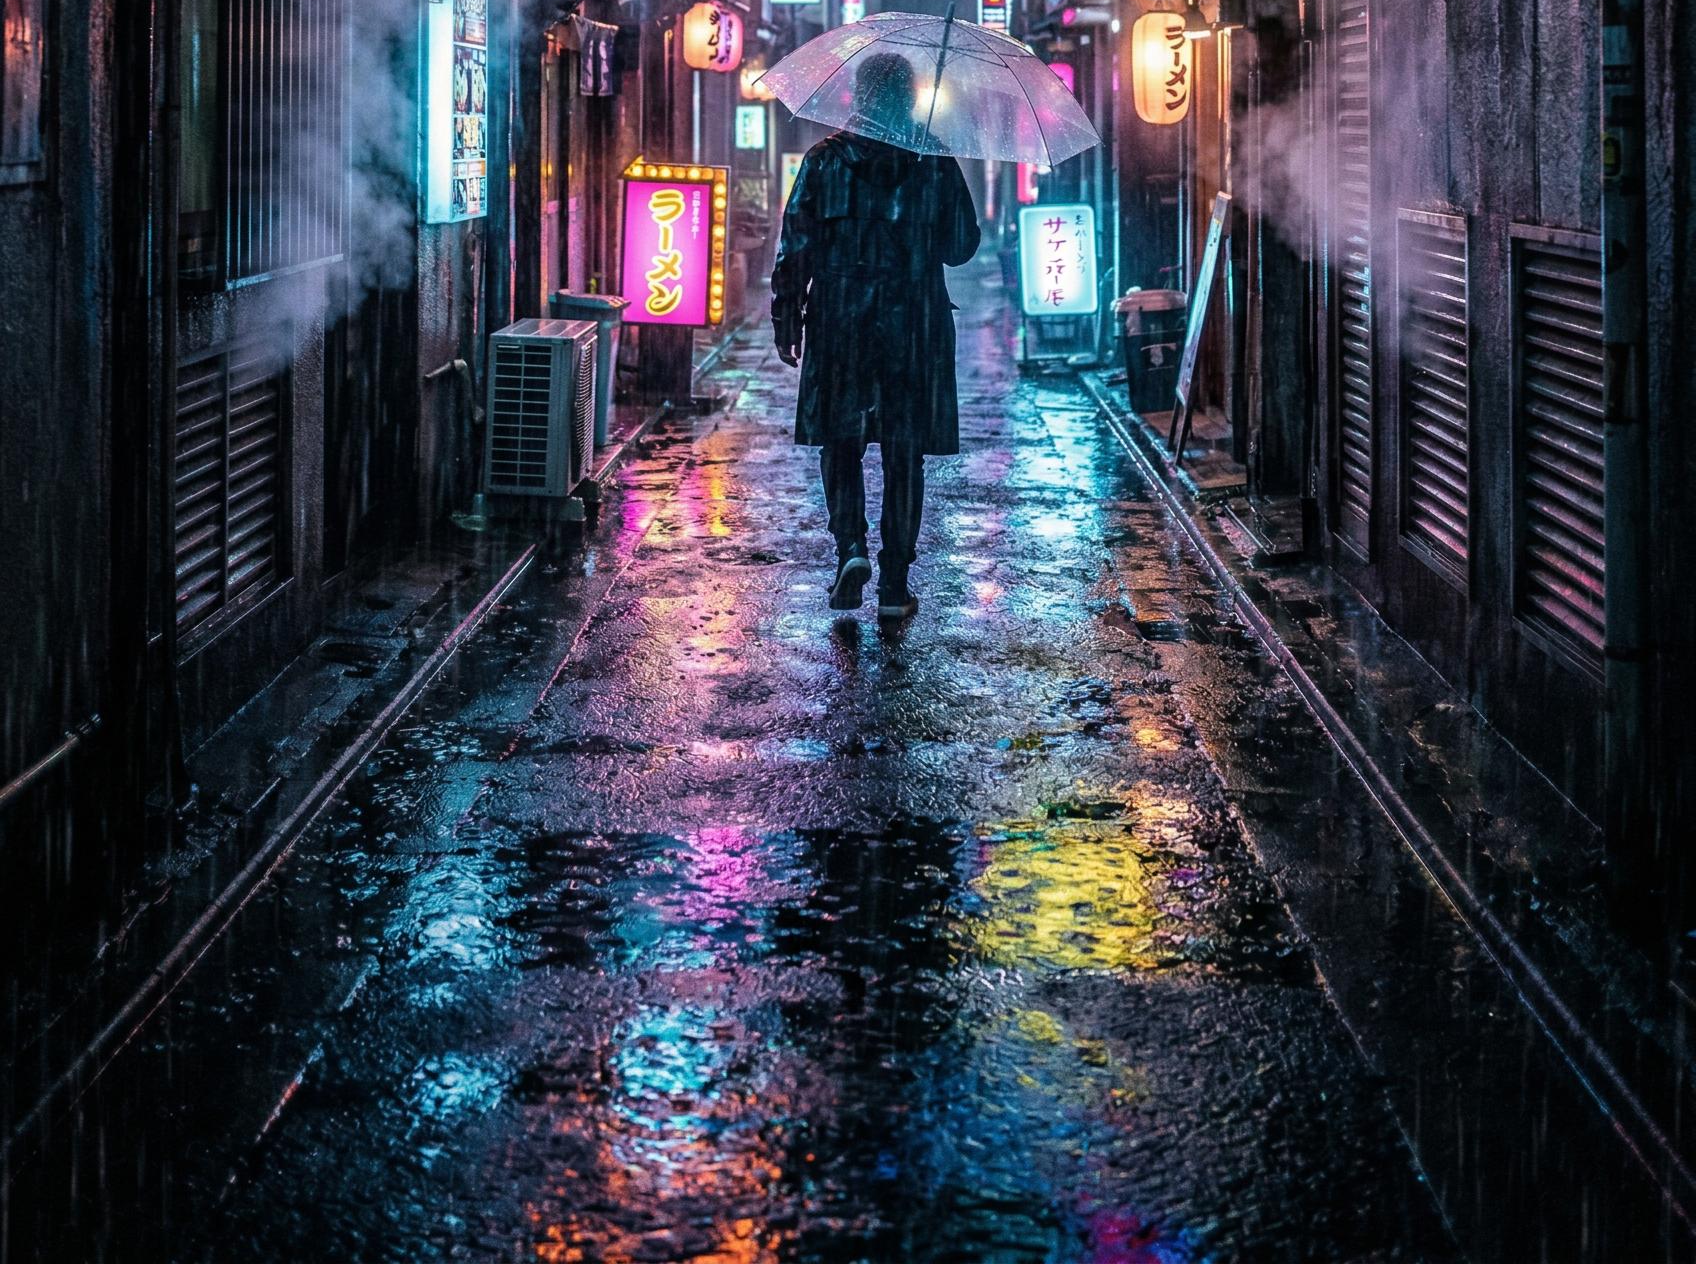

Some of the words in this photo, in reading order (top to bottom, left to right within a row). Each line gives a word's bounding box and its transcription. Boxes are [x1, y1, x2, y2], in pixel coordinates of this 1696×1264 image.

[1165, 26, 1188, 111] ラーメン
[645, 189, 686, 316] ラーメン
